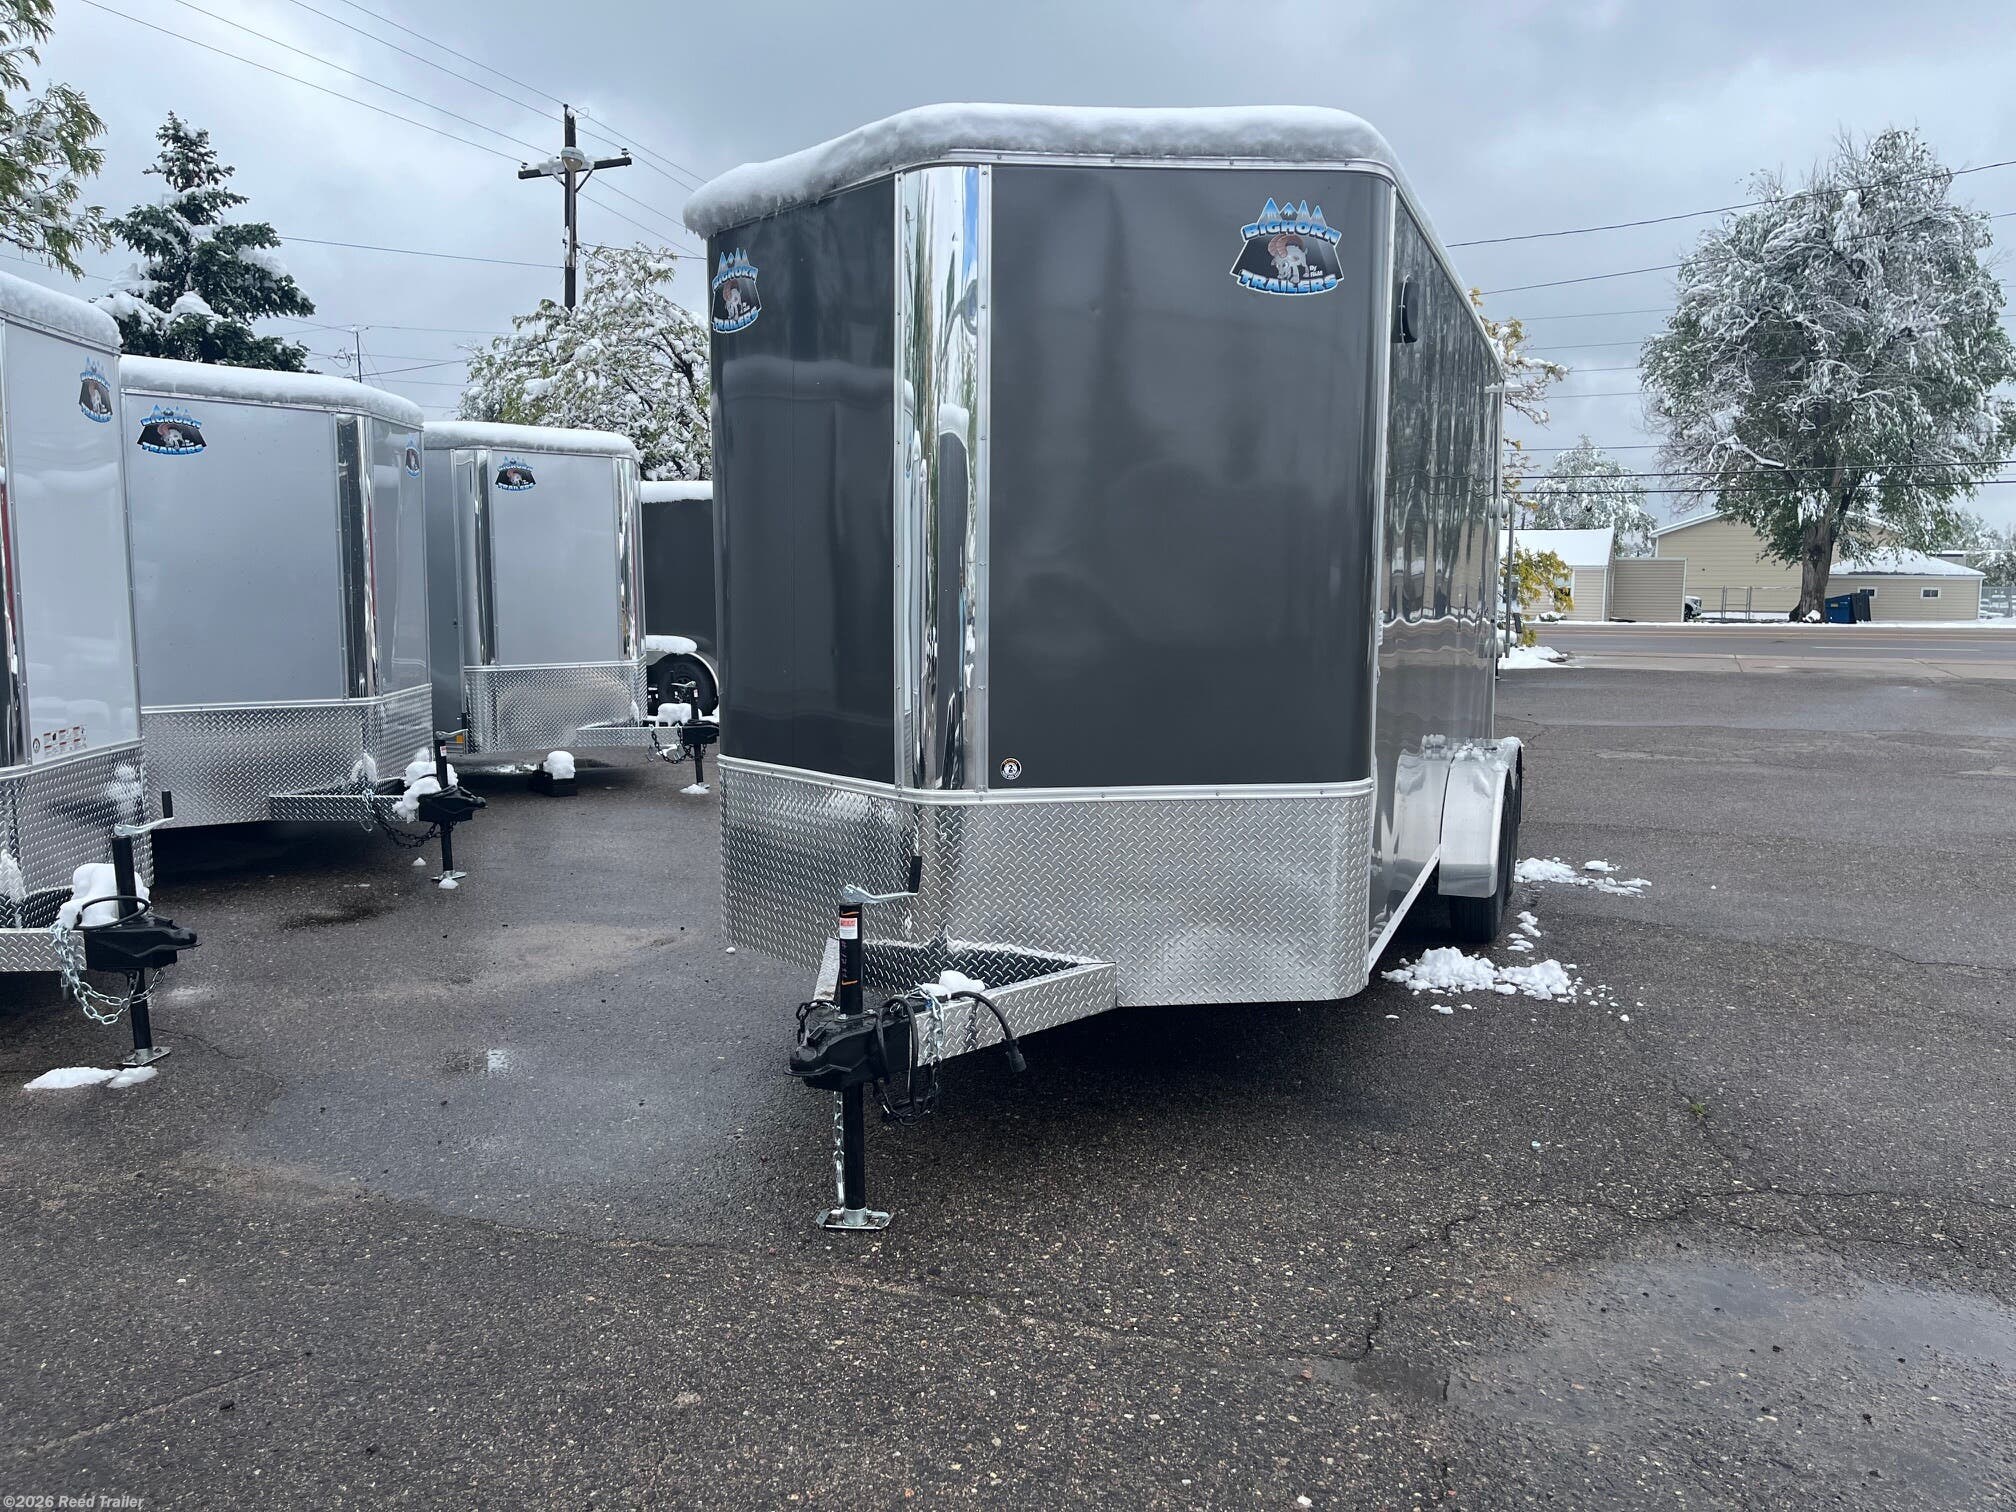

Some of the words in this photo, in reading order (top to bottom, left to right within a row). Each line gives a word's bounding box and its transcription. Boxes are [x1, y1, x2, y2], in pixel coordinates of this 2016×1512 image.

[1241, 219, 1341, 247] BIGHORN
[1239, 269, 1338, 294] TRAILERS
[140, 415, 202, 430] BIGHORN
[141, 441, 204, 456] TRAILERS
